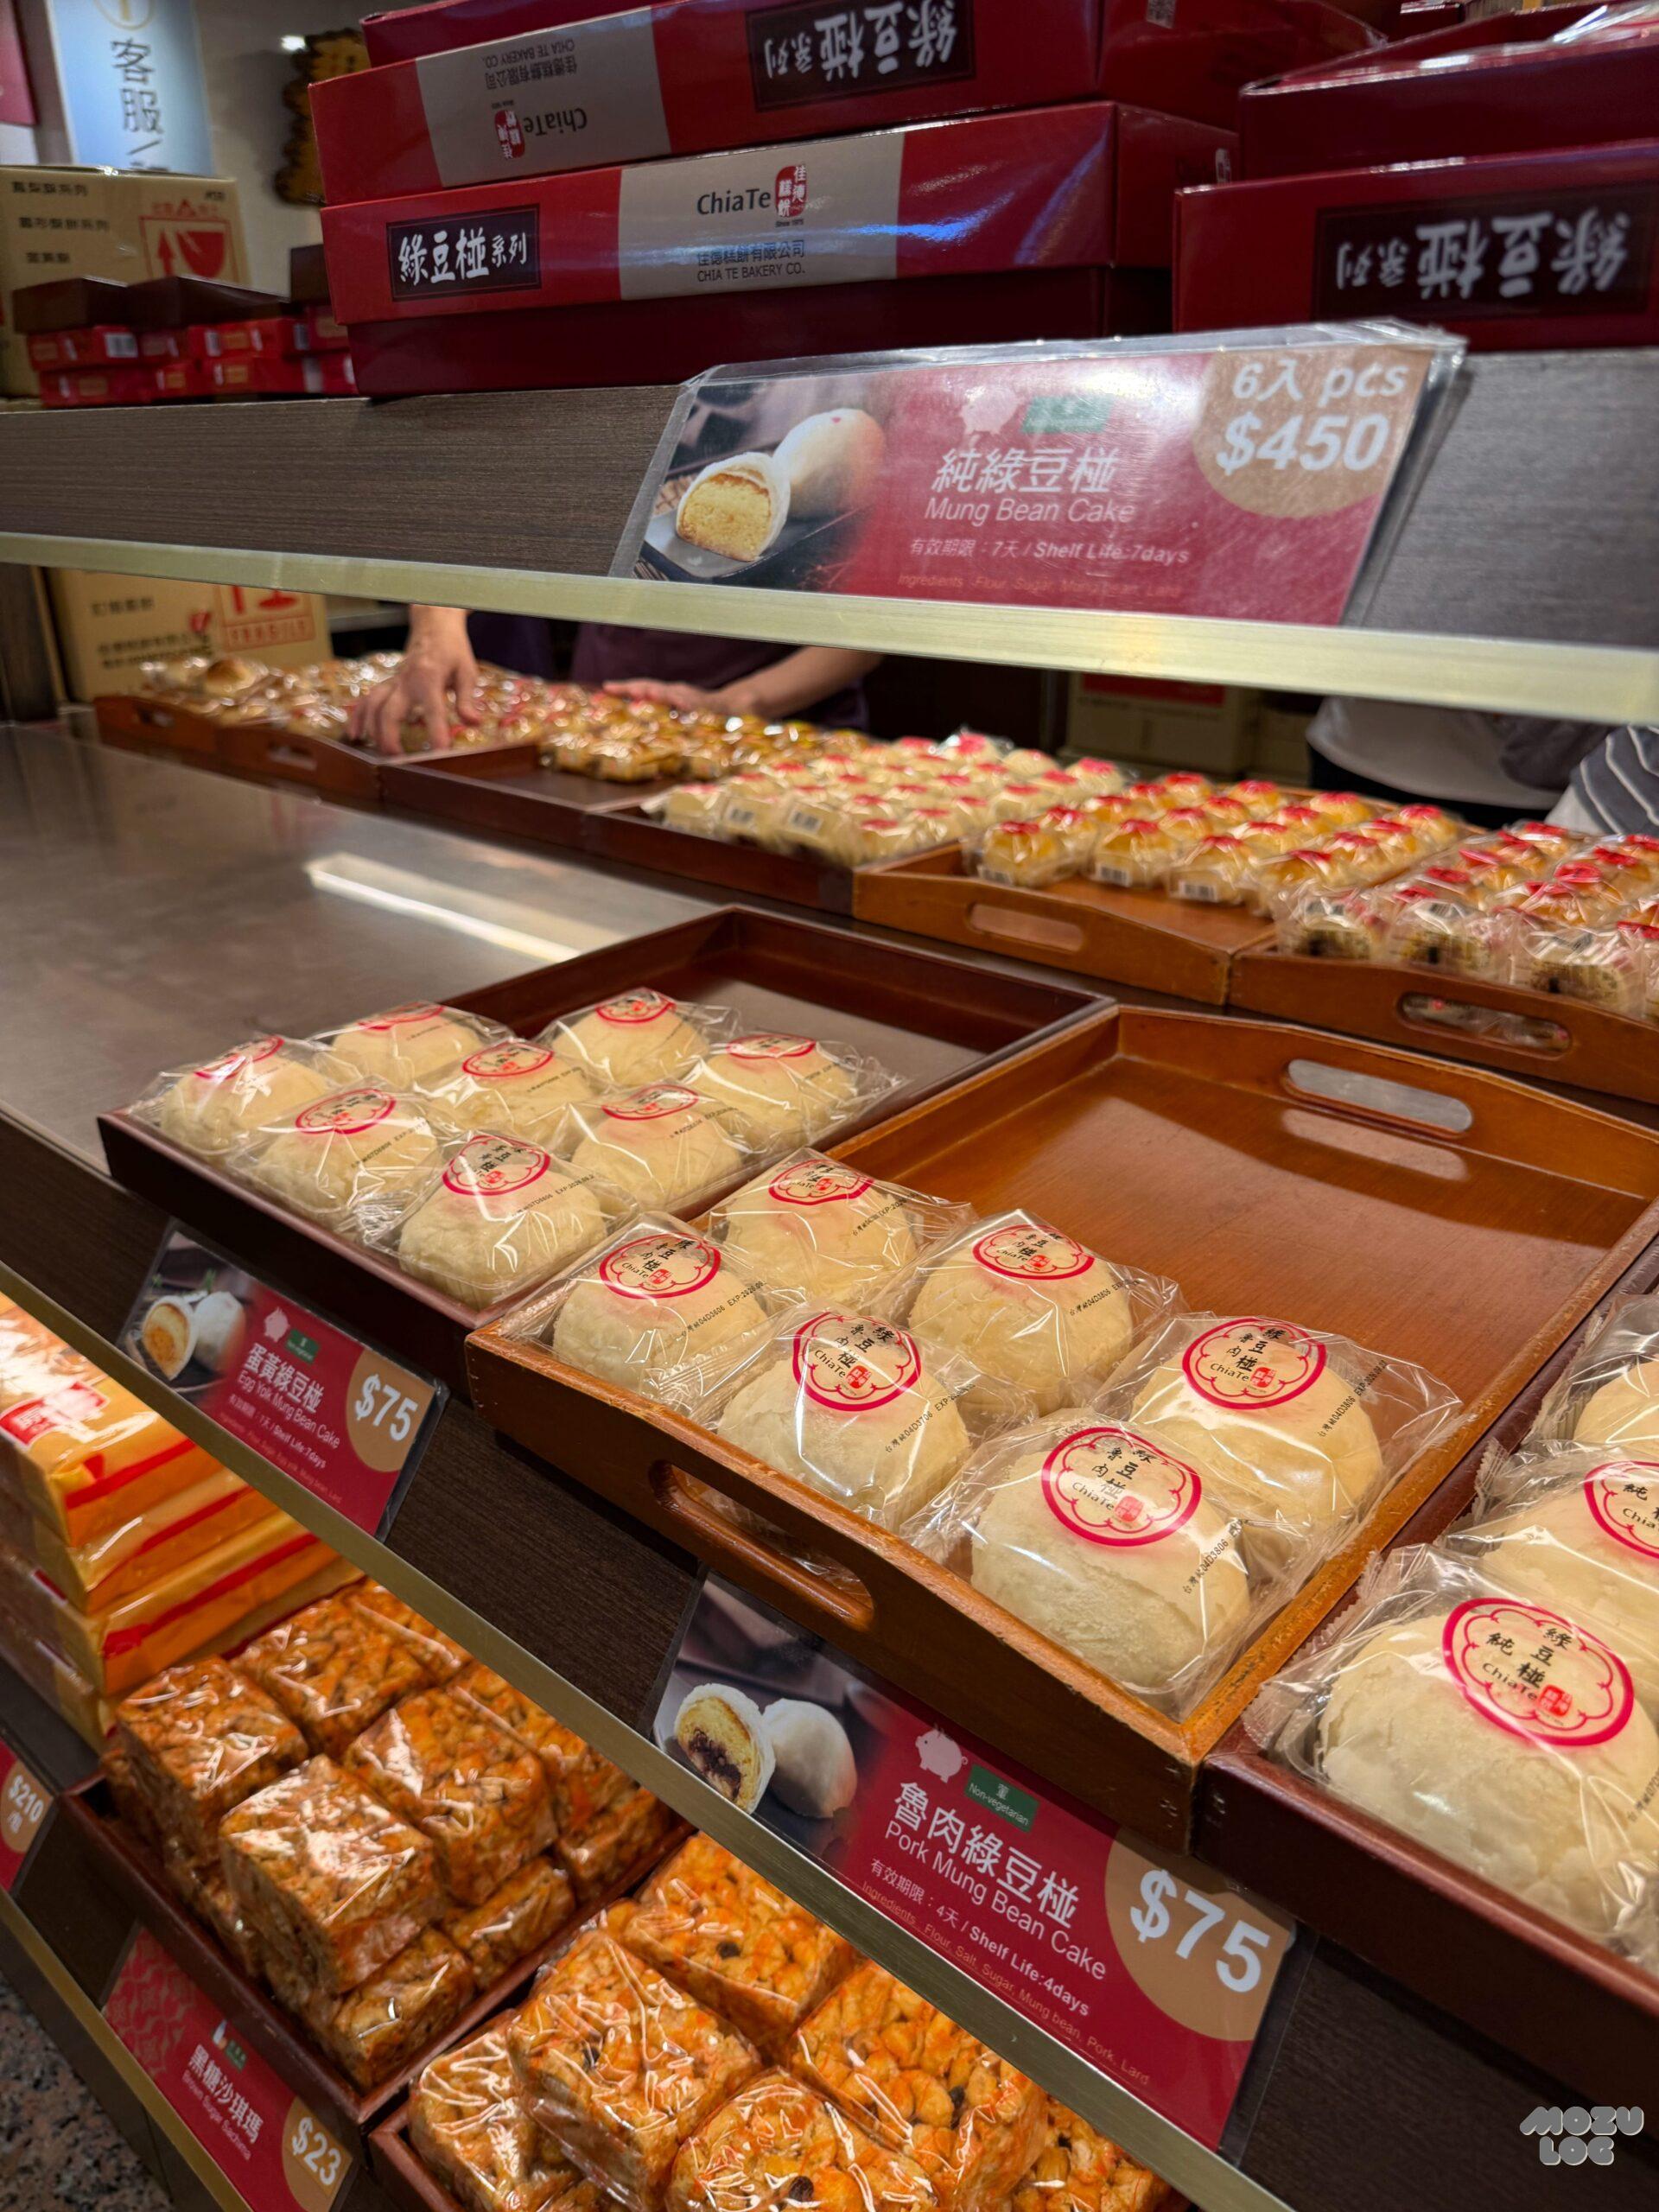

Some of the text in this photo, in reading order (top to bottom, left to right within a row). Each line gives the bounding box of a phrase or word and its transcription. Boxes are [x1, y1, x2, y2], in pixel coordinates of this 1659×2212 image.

[111, 39, 169, 172] 客服/
[524, 108, 588, 137] ChiaTe
[697, 188, 771, 215] ChiaTe
[397, 226, 528, 286] 綠豆椪系列
[697, 262, 805, 282] CHIA TE BAKERY CO.
[1336, 207, 1630, 301] 綠豆椪系列
[1232, 359, 1409, 408] 6入 pcs
[1217, 411, 1390, 475] $450
[931, 448, 1119, 493] 純綠豆椪
[925, 497, 1136, 527] Mung Bean Cake
[1033, 543, 1083, 559] Shelf
[622, 1262, 649, 1279] ChiaTe
[815, 1350, 846, 1378] ChiaTe
[1210, 1363, 1249, 1382] ChiaTe
[1236, 1327, 1286, 1372] 綠豆椪
[244, 1342, 325, 1414] 蛋黃綠豆椪
[238, 1370, 257, 1393] Egg
[272, 1392, 295, 1421] Mung
[294, 1408, 317, 1433] Bean
[316, 1424, 340, 1449] Cake
[355, 1374, 418, 1442] $75
[1071, 1482, 1115, 1510] ChiaTe
[1623, 1508, 1659, 1532] Chia
[1485, 1631, 1515, 1656] 純
[1516, 1628, 1573, 1688] 綠豆椪
[1482, 1662, 1538, 1700] ChiaTe
[9, 1775, 44, 1822] $210
[894, 1782, 1079, 1929] 魯肉綠豆椪
[884, 1821, 1106, 1980] Pork Mung Bean Cake
[1129, 1868, 1270, 1993] $75
[969, 1926, 1009, 1960] Shelf
[1010, 1953, 1090, 2017] Life:4days
[1019, 1989, 1050, 2020] Mung
[1121, 2059, 1151, 2085] Lard
[291, 2116, 343, 2187] $23
